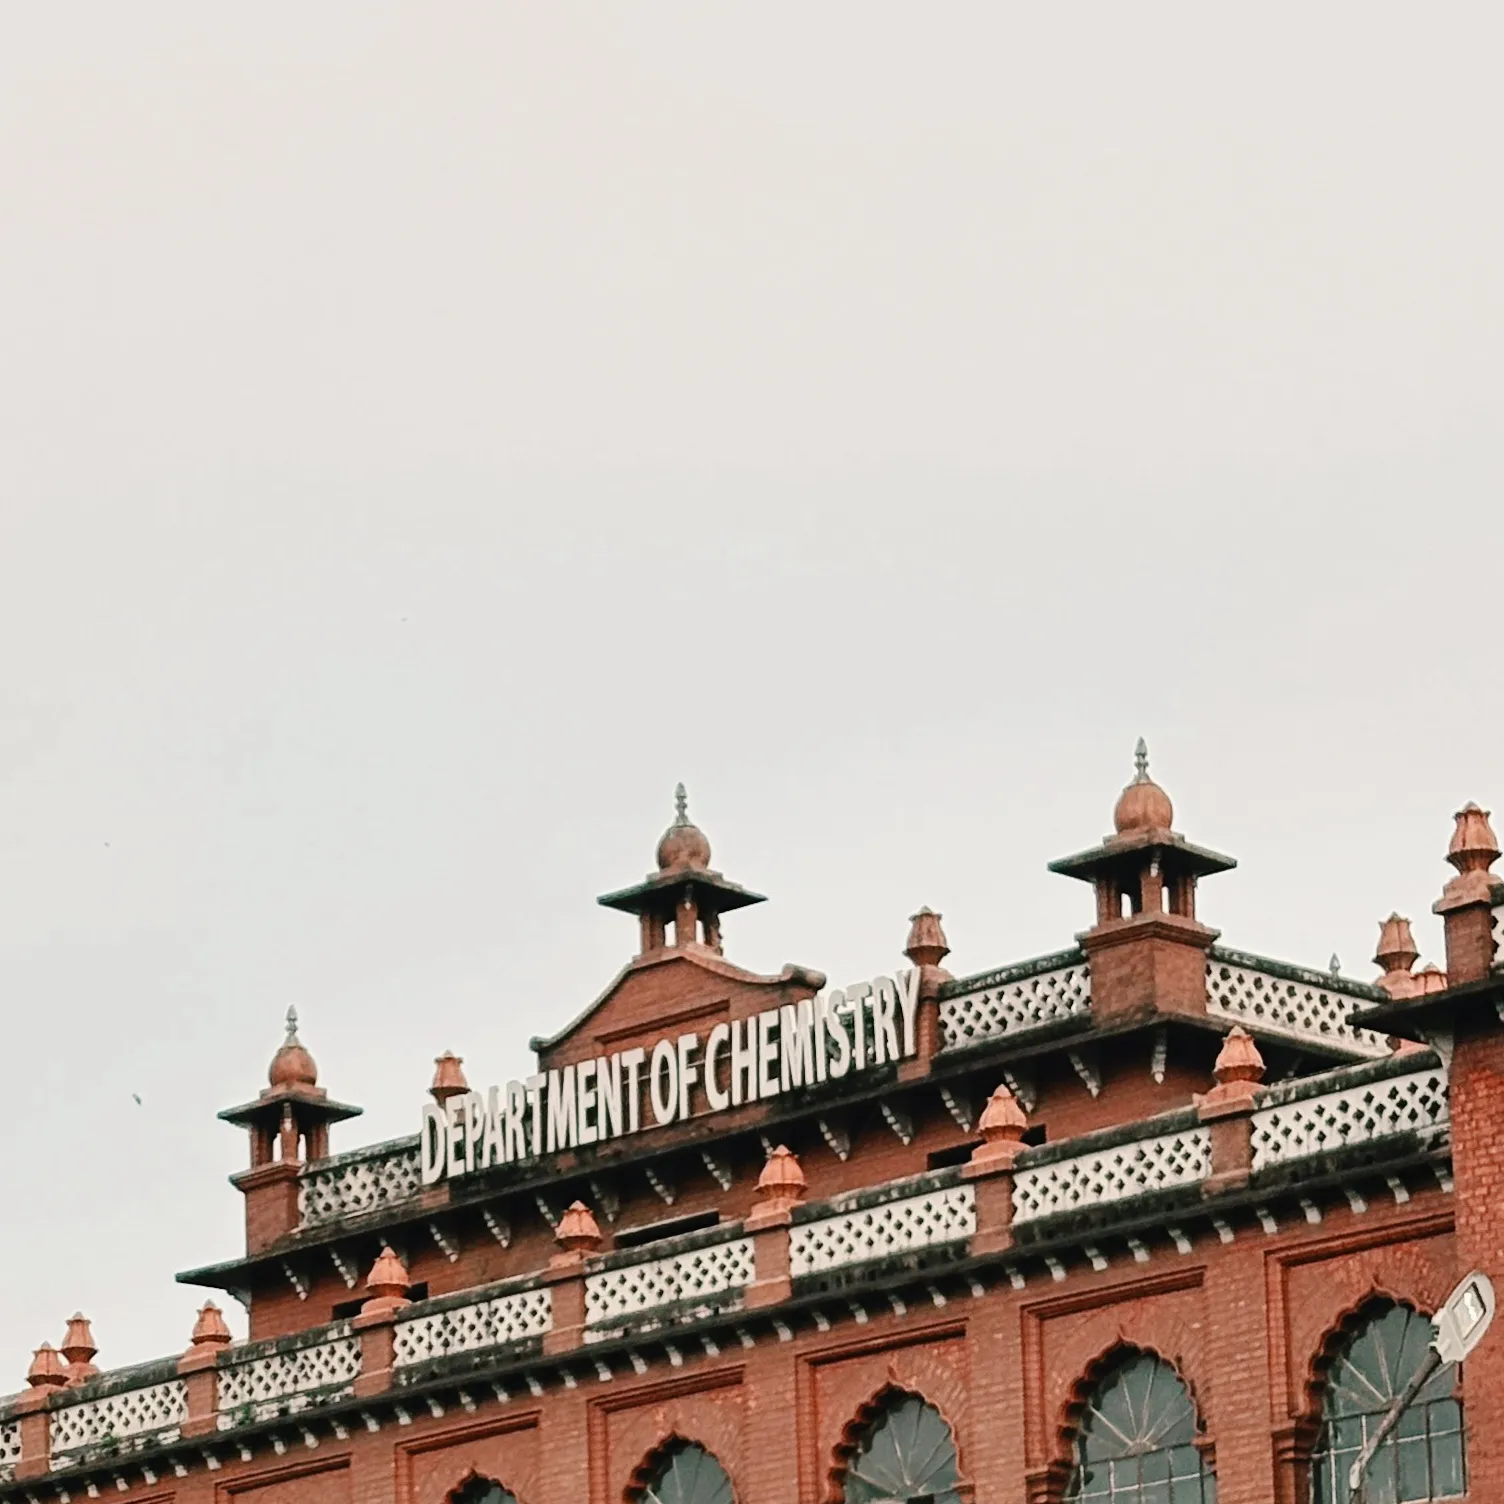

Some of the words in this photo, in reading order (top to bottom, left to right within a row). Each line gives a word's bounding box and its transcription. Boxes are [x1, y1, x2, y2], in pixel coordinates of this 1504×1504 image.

[421, 1046, 645, 1185] DEPARTMENT
[650, 1032, 698, 1127] OF
[704, 965, 923, 1112] CHEMISTRY
